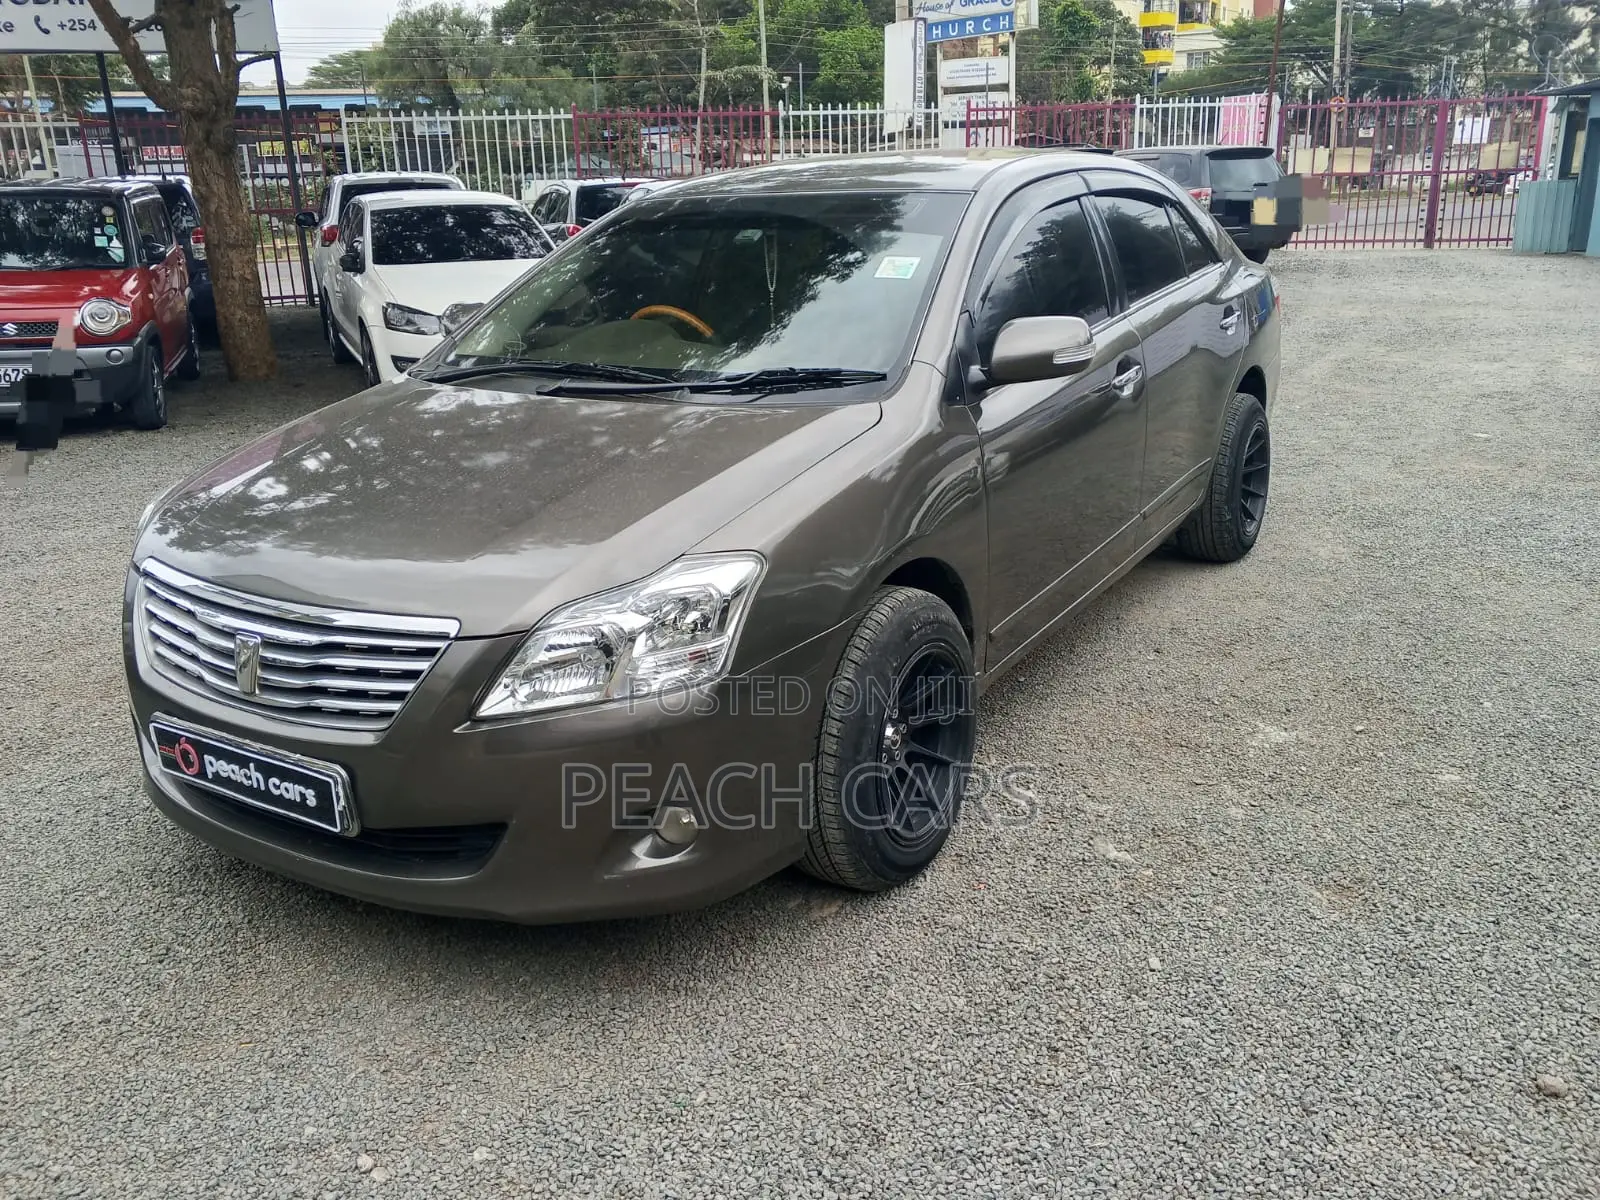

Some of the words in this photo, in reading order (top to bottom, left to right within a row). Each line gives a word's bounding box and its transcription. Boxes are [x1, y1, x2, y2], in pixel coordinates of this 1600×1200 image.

[57, 18, 98, 32] +254
[932, 15, 1010, 39] HURCH
[203, 753, 266, 791] peach
[267, 777, 318, 808] cars
